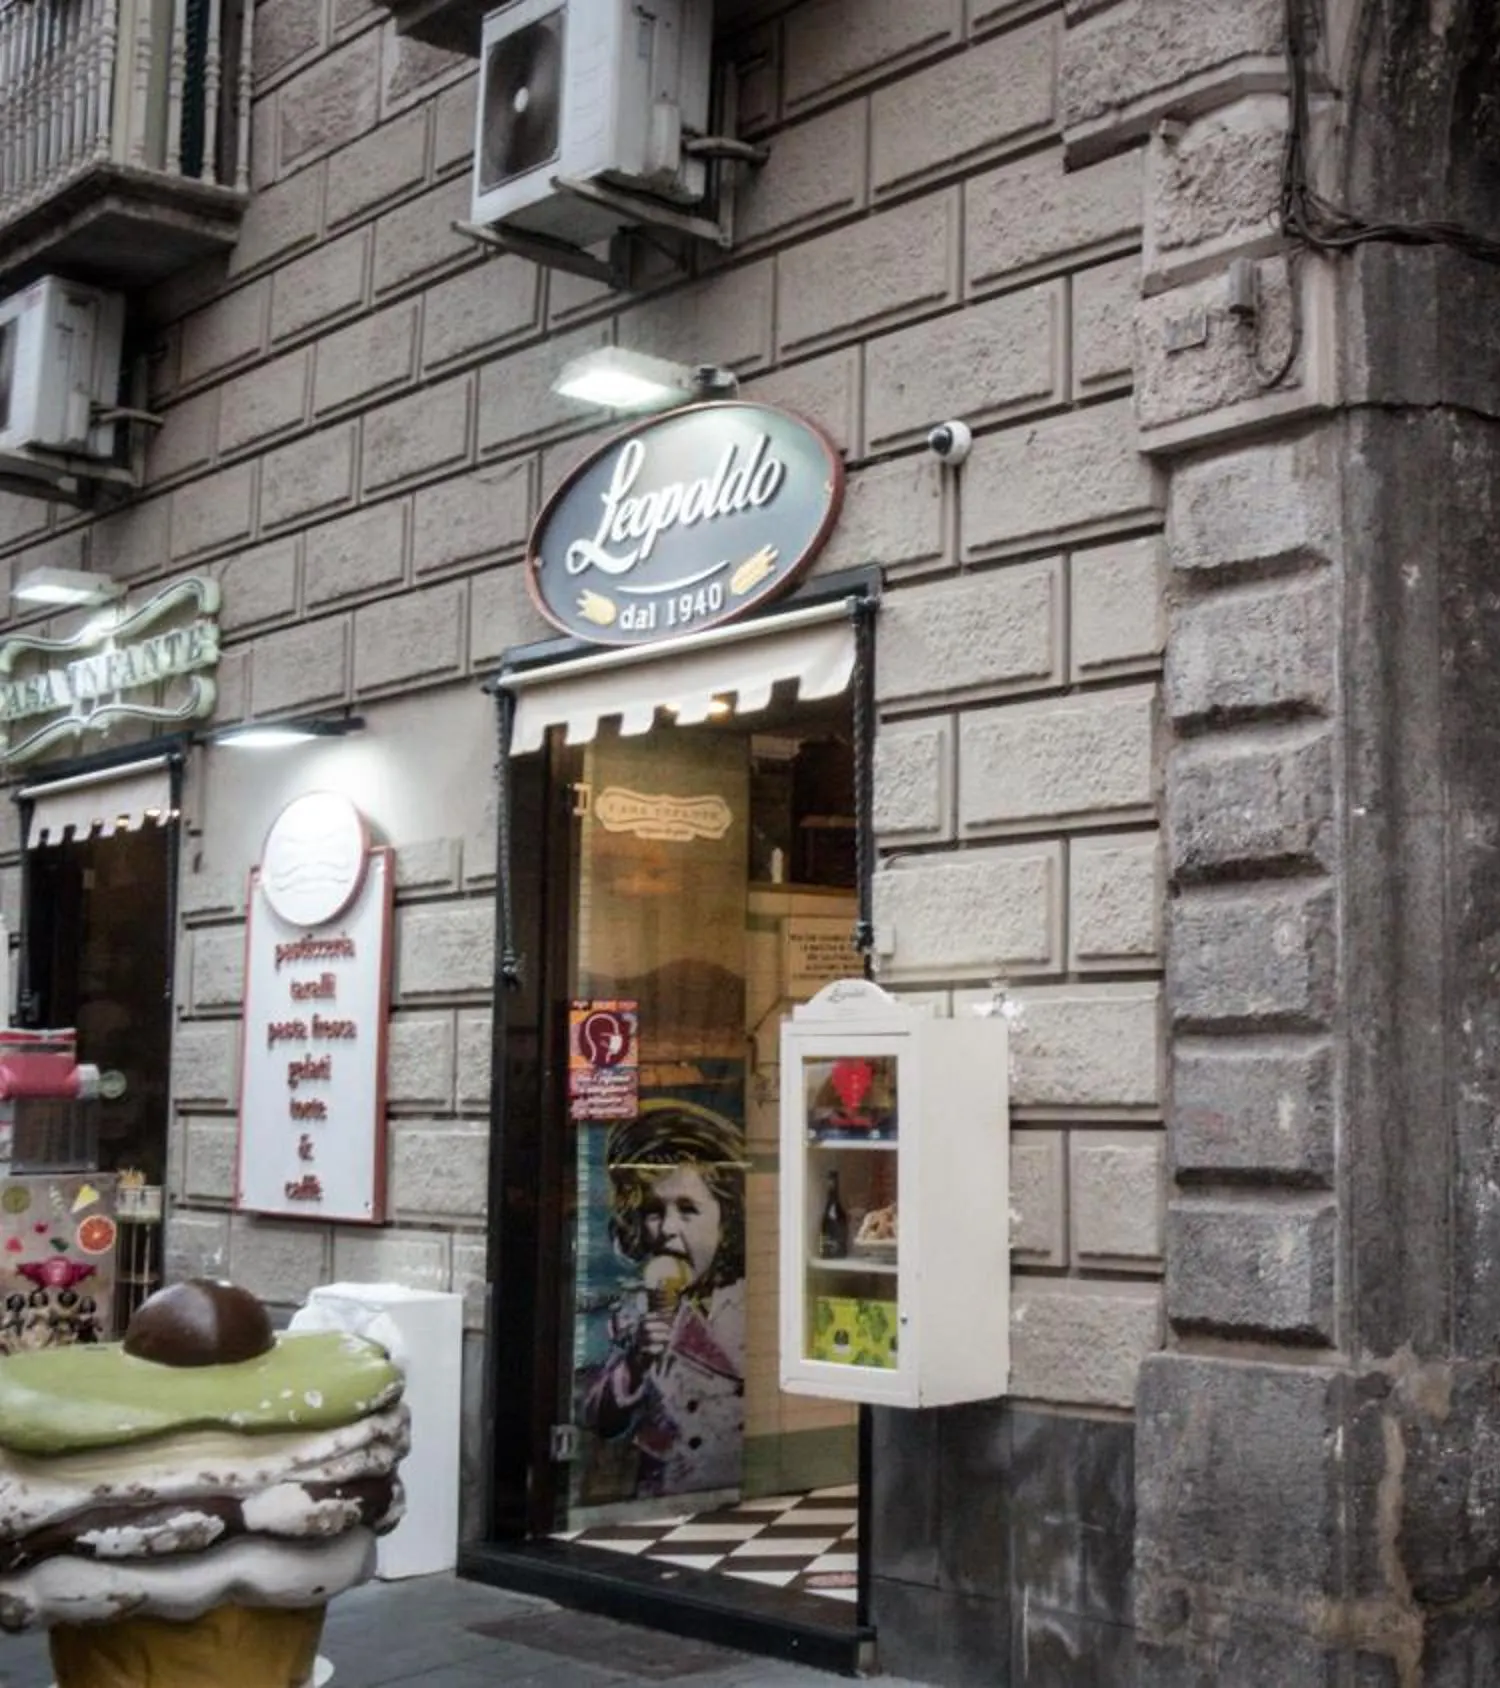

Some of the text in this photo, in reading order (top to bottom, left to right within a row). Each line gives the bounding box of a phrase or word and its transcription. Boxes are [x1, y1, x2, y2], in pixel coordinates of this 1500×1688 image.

[566, 432, 786, 575] Leopoldo
[619, 583, 723, 630] dal 1940
[267, 1018, 308, 1049] pasta
